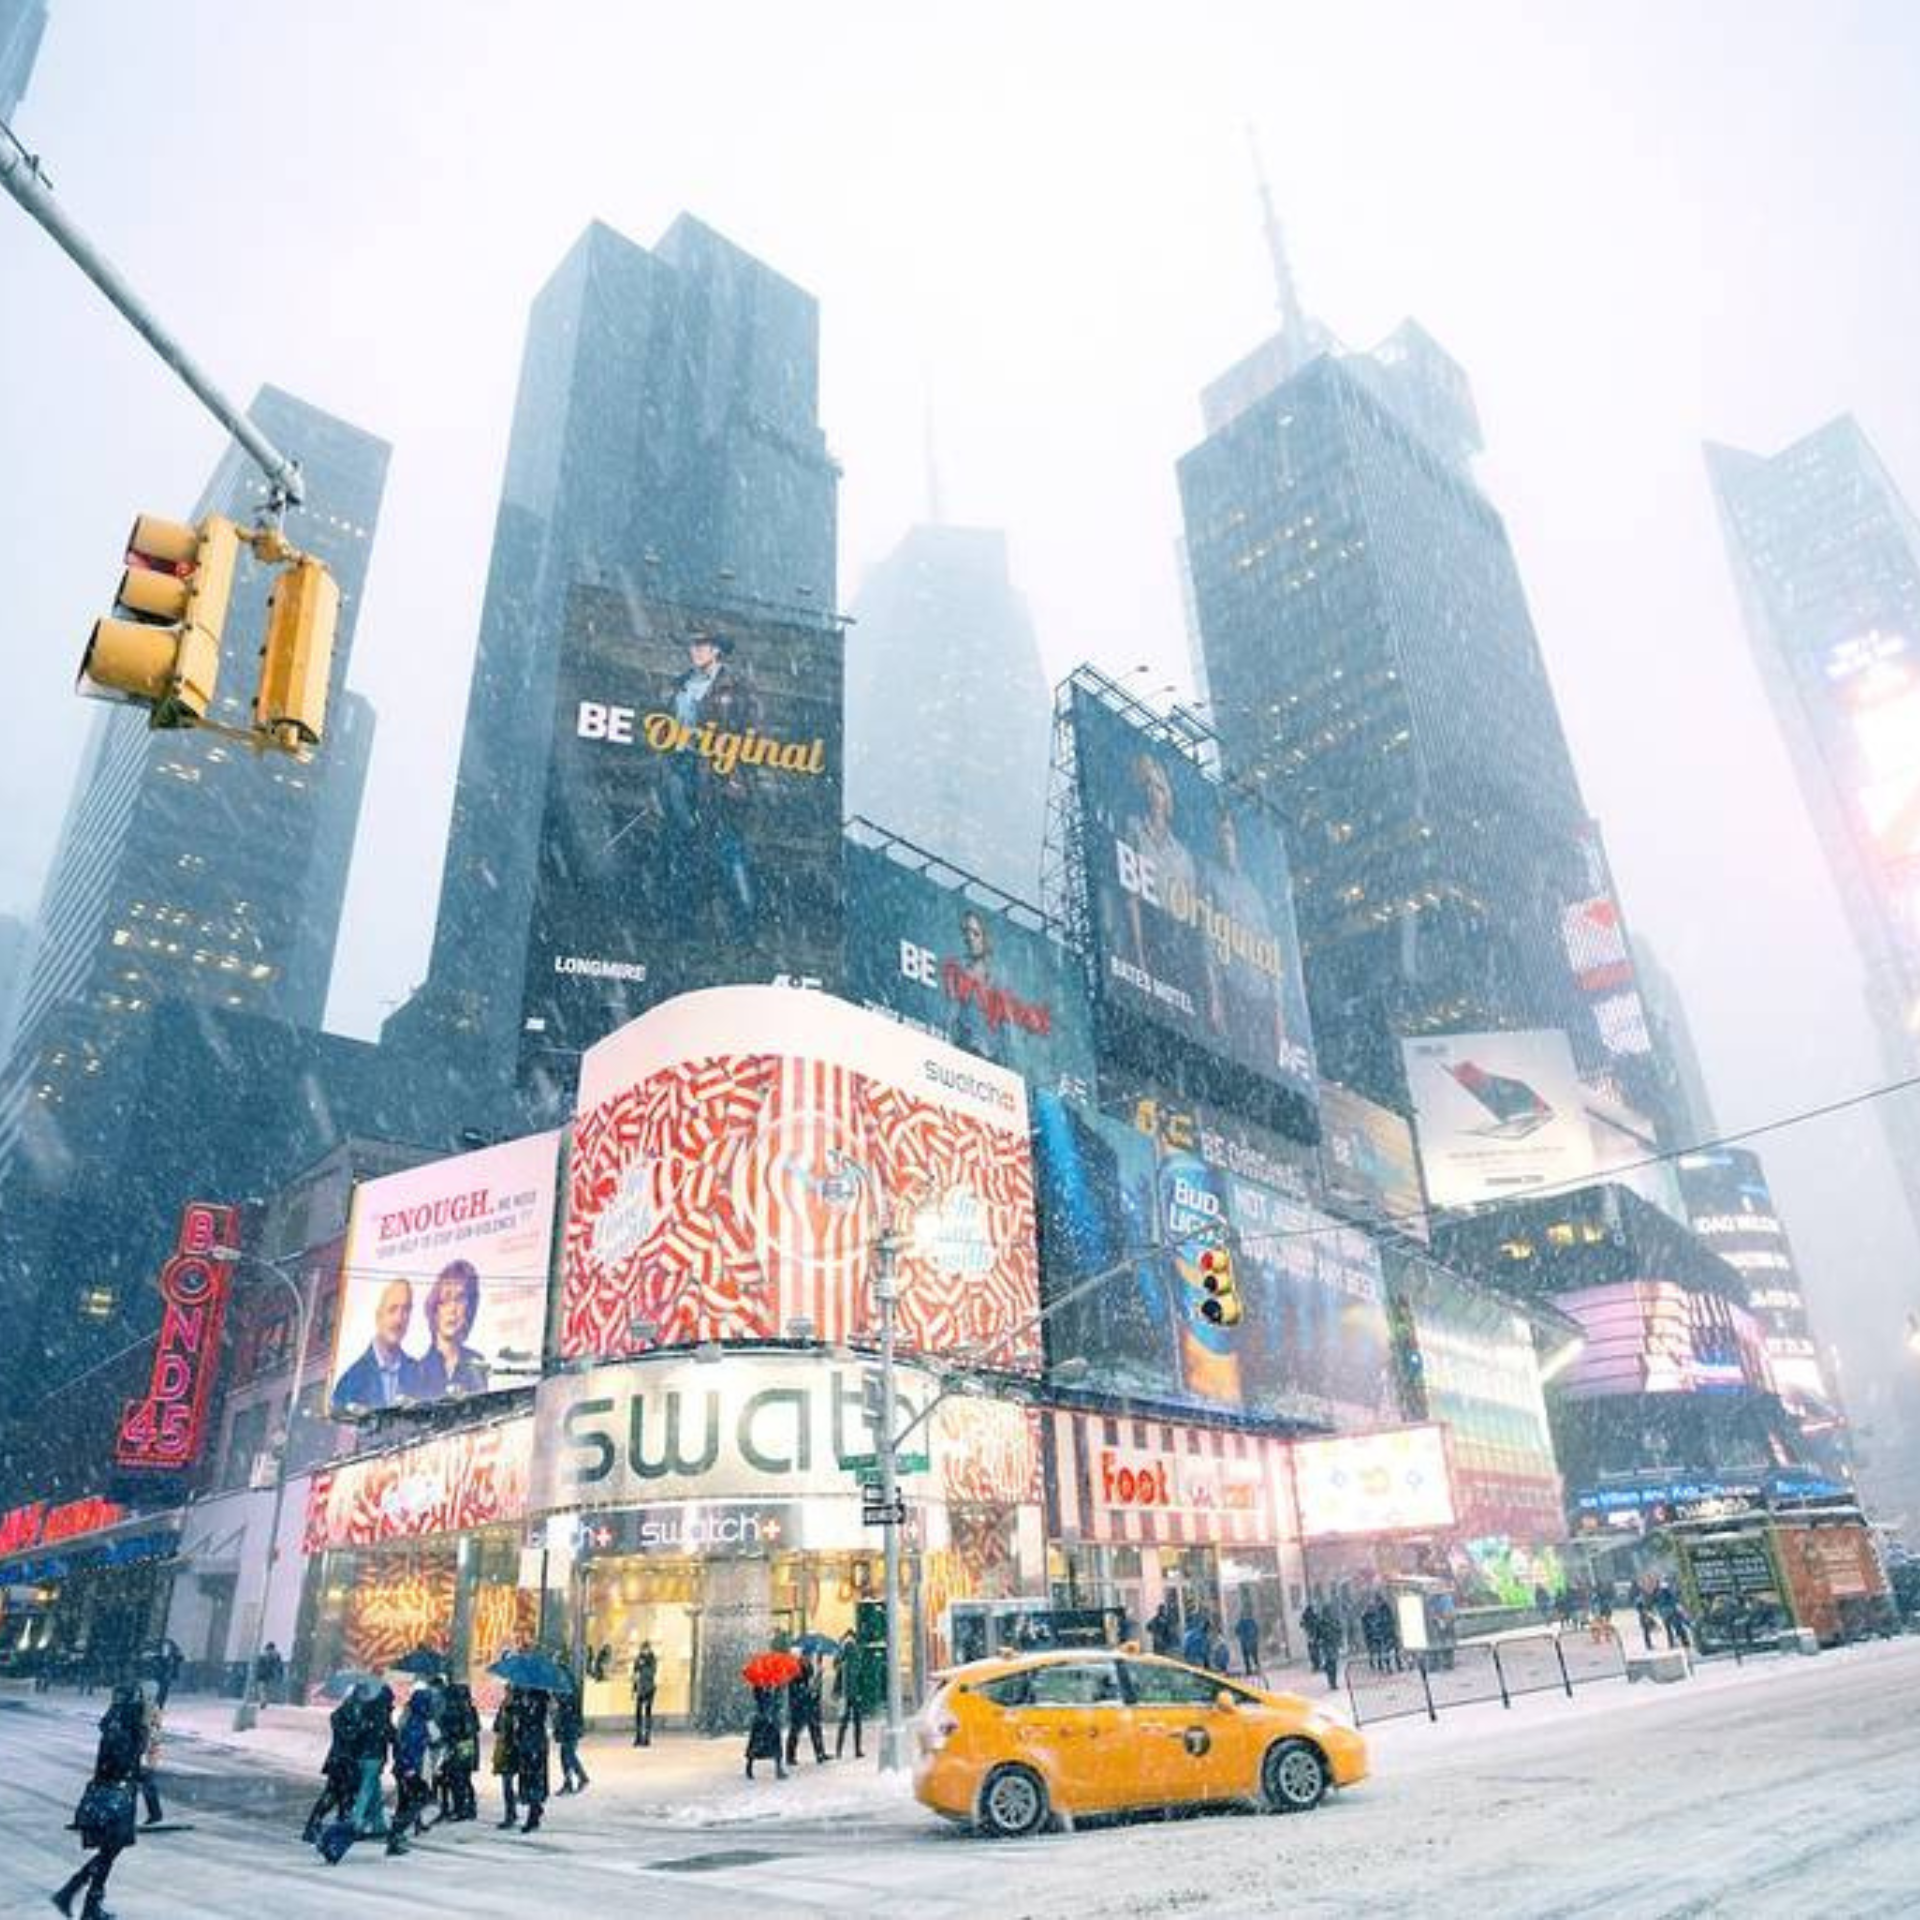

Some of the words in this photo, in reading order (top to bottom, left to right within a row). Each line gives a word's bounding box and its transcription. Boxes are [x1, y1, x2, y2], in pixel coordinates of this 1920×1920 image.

[577, 701, 635, 744] BE
[644, 712, 825, 776] Original
[1116, 839, 1161, 908] BE
[555, 955, 647, 983] LONGMIRE
[901, 939, 938, 988] BE
[379, 1189, 494, 1241] ENOUGH.
[1176, 1177, 1219, 1215] BUD
[159, 1210, 215, 1401] BOND
[121, 1400, 194, 1455] 45
[1101, 1451, 1170, 1507] Foot
